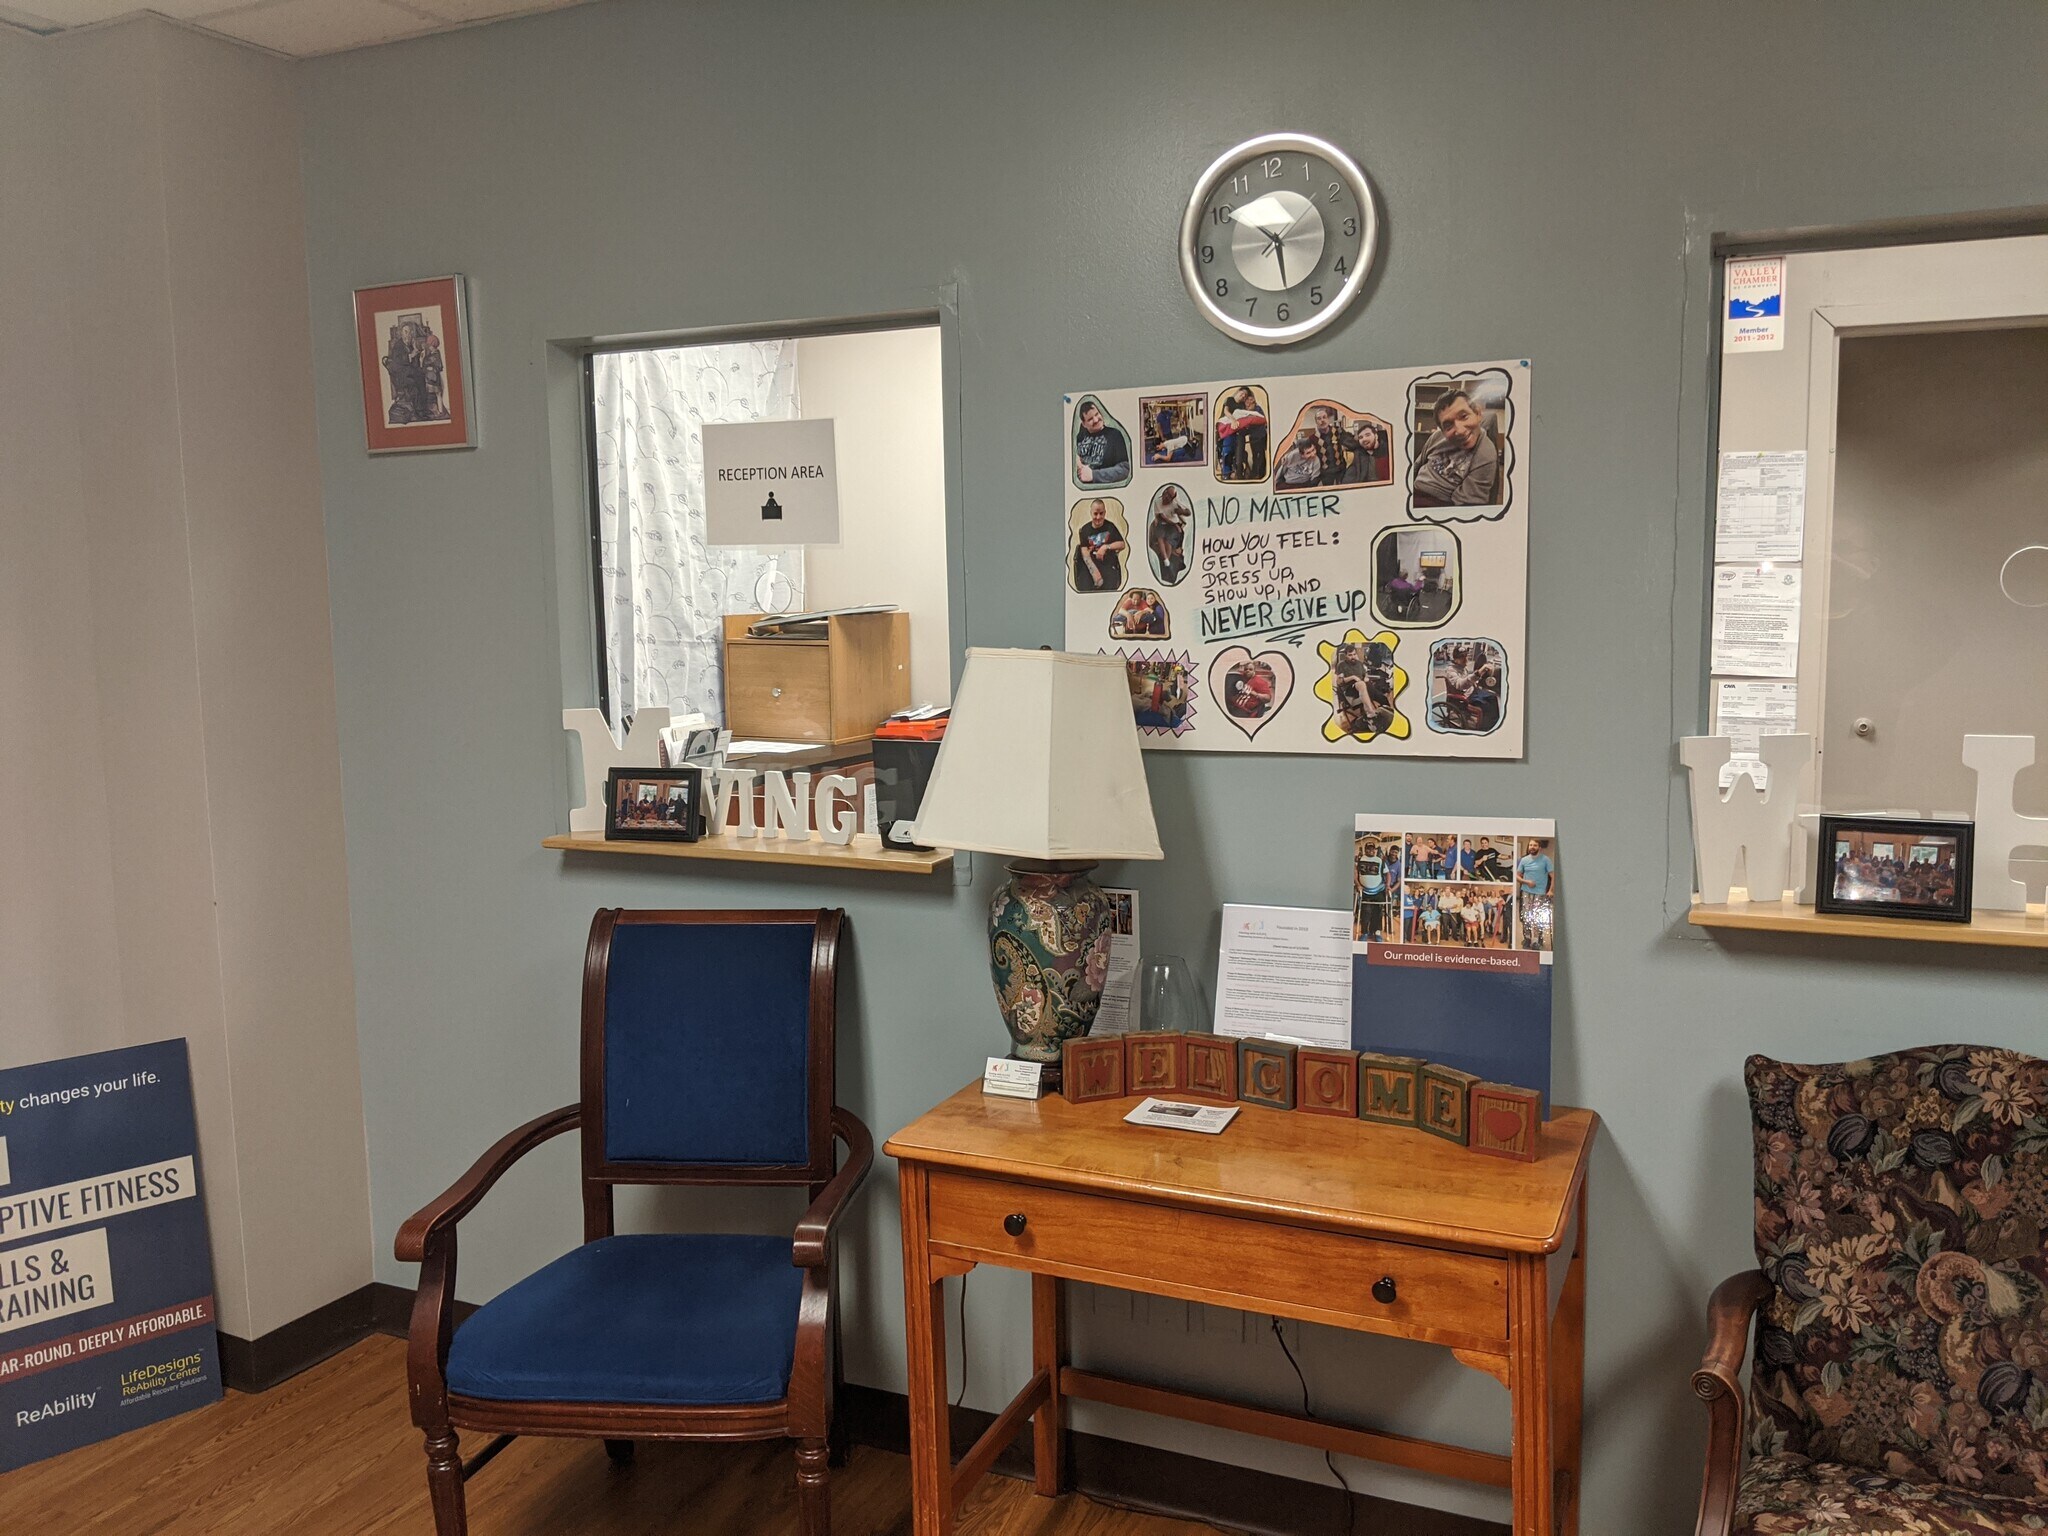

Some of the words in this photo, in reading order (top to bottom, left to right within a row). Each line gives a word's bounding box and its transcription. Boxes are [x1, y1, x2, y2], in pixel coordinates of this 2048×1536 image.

[1261, 158, 1282, 178] 12
[1302, 162, 1310, 181] 1
[1231, 175, 1249, 195] 11
[1328, 183, 1341, 203] 2
[1210, 205, 1232, 225] 10
[1343, 218, 1356, 237] 3
[1201, 246, 1214, 264] 9
[1334, 256, 1347, 275] 4
[1734, 266, 1777, 277] VALLEY
[1216, 278, 1228, 297] 8
[1733, 275, 1778, 285] CHAMBER
[1310, 286, 1322, 305] 5
[1245, 297, 1258, 317] 7
[1277, 303, 1290, 321] 6
[718, 466, 787, 481] RECEPTION
[791, 465, 824, 480] AREA
[1207, 496, 1240, 528] NO
[1250, 495, 1340, 522] MATTER
[1202, 537, 1235, 554] HOW
[1239, 532, 1270, 553] YOU
[1276, 530, 1340, 549] FEEL:
[1202, 553, 1239, 571] GET
[1202, 569, 1261, 589] DRESS
[1204, 588, 1248, 604] SHOW
[1254, 584, 1280, 600] UP,
[1287, 578, 1321, 596] AND
[1201, 601, 1273, 636] NEVER
[1281, 596, 1327, 623] GIVE
[1336, 590, 1366, 621] UP
[562, 707, 858, 845] MVING
[1383, 950, 1402, 960] Our
[1404, 951, 1434, 962] model
[1435, 953, 1442, 962] is
[1444, 955, 1521, 967] evidence-based.
[19, 1086, 90, 1109] changes
[94, 1078, 129, 1098] your
[132, 1071, 161, 1087] life.
[1080, 1047, 1457, 1128] WELCOME
[0, 1192, 73, 1235] PTIVE
[80, 1167, 180, 1215] FITNESS
[50, 1249, 70, 1275] &
[0, 1342, 76, 1376] AR-ROUND.
[79, 1327, 125, 1353] DEEPLY
[129, 1304, 207, 1339] AFFORDABLE.
[121, 1353, 202, 1386] LifeDesigns
[122, 1377, 168, 1396] ReAbility
[169, 1366, 202, 1381] Center
[16, 1391, 97, 1427] ReAbility
